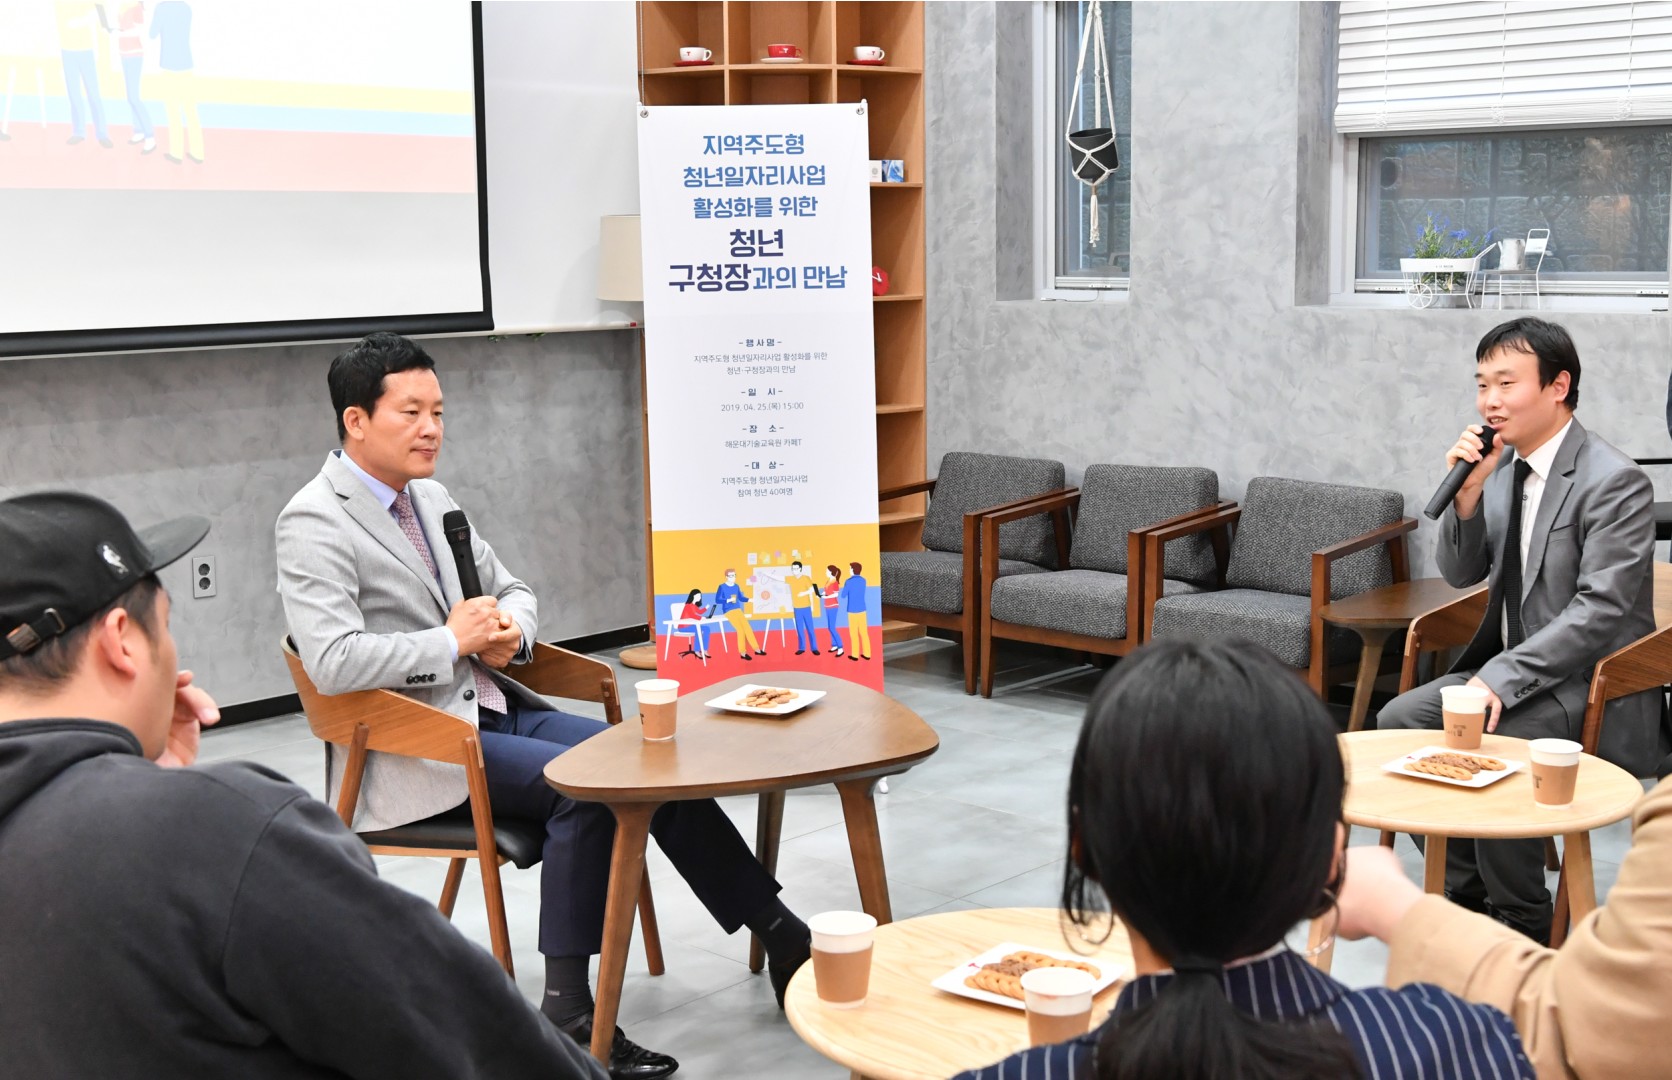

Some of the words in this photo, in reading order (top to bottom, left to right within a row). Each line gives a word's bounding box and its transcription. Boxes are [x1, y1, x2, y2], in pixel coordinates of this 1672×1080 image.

[703, 134, 804, 155] 지역주도형
[684, 165, 825, 187] 청년일자리사업
[694, 197, 773, 219] 활성화를
[779, 196, 818, 217] 위한
[730, 229, 783, 257] 청년
[669, 263, 796, 292] 구청장과의
[803, 266, 848, 289] 만남
[694, 355, 729, 363] 지역주도형
[732, 353, 781, 362] 청년일자리사업
[783, 353, 811, 361] 활성화를
[814, 352, 827, 360] 위한
[782, 365, 795, 373] 만남
[784, 402, 804, 410] 15:00
[725, 439, 781, 448] 해운대기술교육원
[784, 439, 802, 447] 카페T
[722, 477, 756, 485] 지역주도형
[759, 475, 808, 484] 청년일자리사업
[738, 489, 751, 497] 참여
[754, 489, 767, 497] 청년
